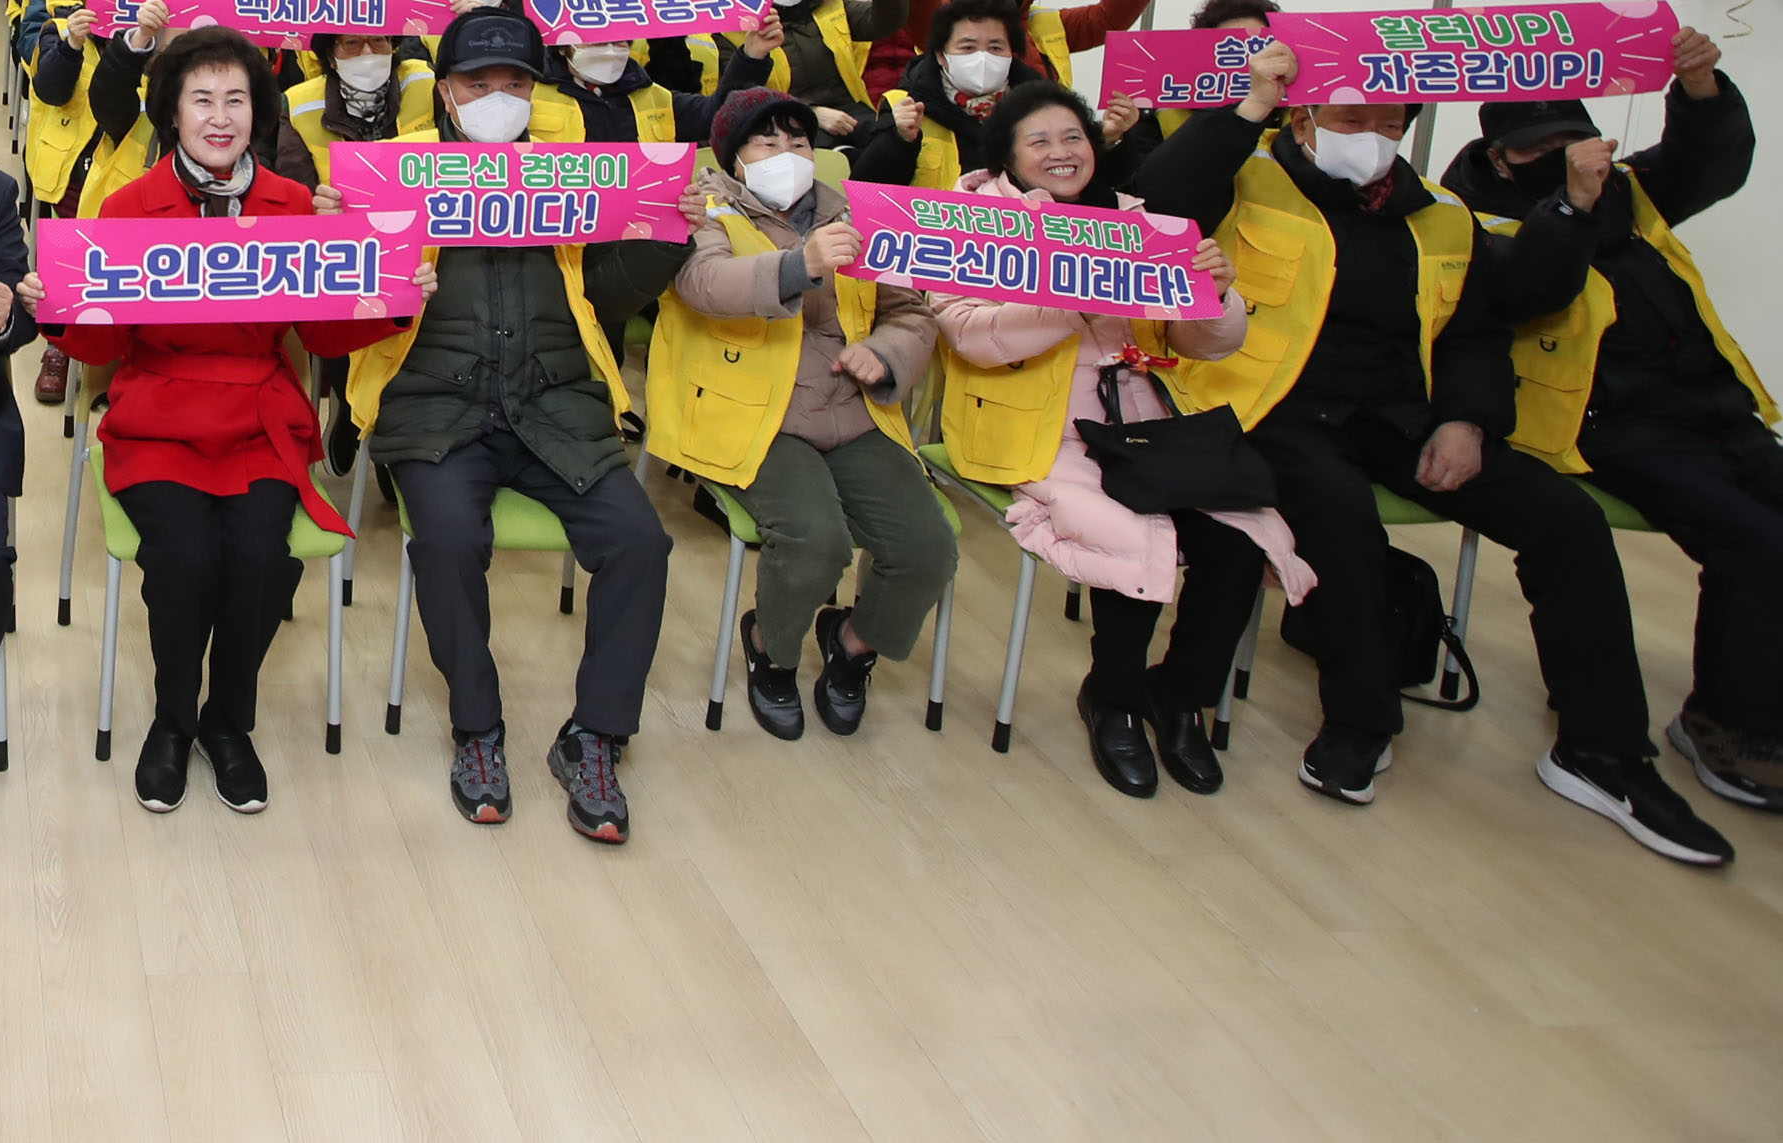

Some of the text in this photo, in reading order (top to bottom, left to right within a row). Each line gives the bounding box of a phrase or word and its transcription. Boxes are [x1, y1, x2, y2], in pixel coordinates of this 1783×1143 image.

[1372, 10, 1574, 51] 활력UP!
[1359, 48, 1604, 94] 자존감UP!
[399, 152, 629, 190] 어르신 경험이
[427, 191, 599, 240] 힘이다!
[910, 199, 1143, 253] 일자리가 복지다!
[81, 237, 381, 303] 노인일자리
[865, 230, 1194, 308] 어르신이 미래다!
